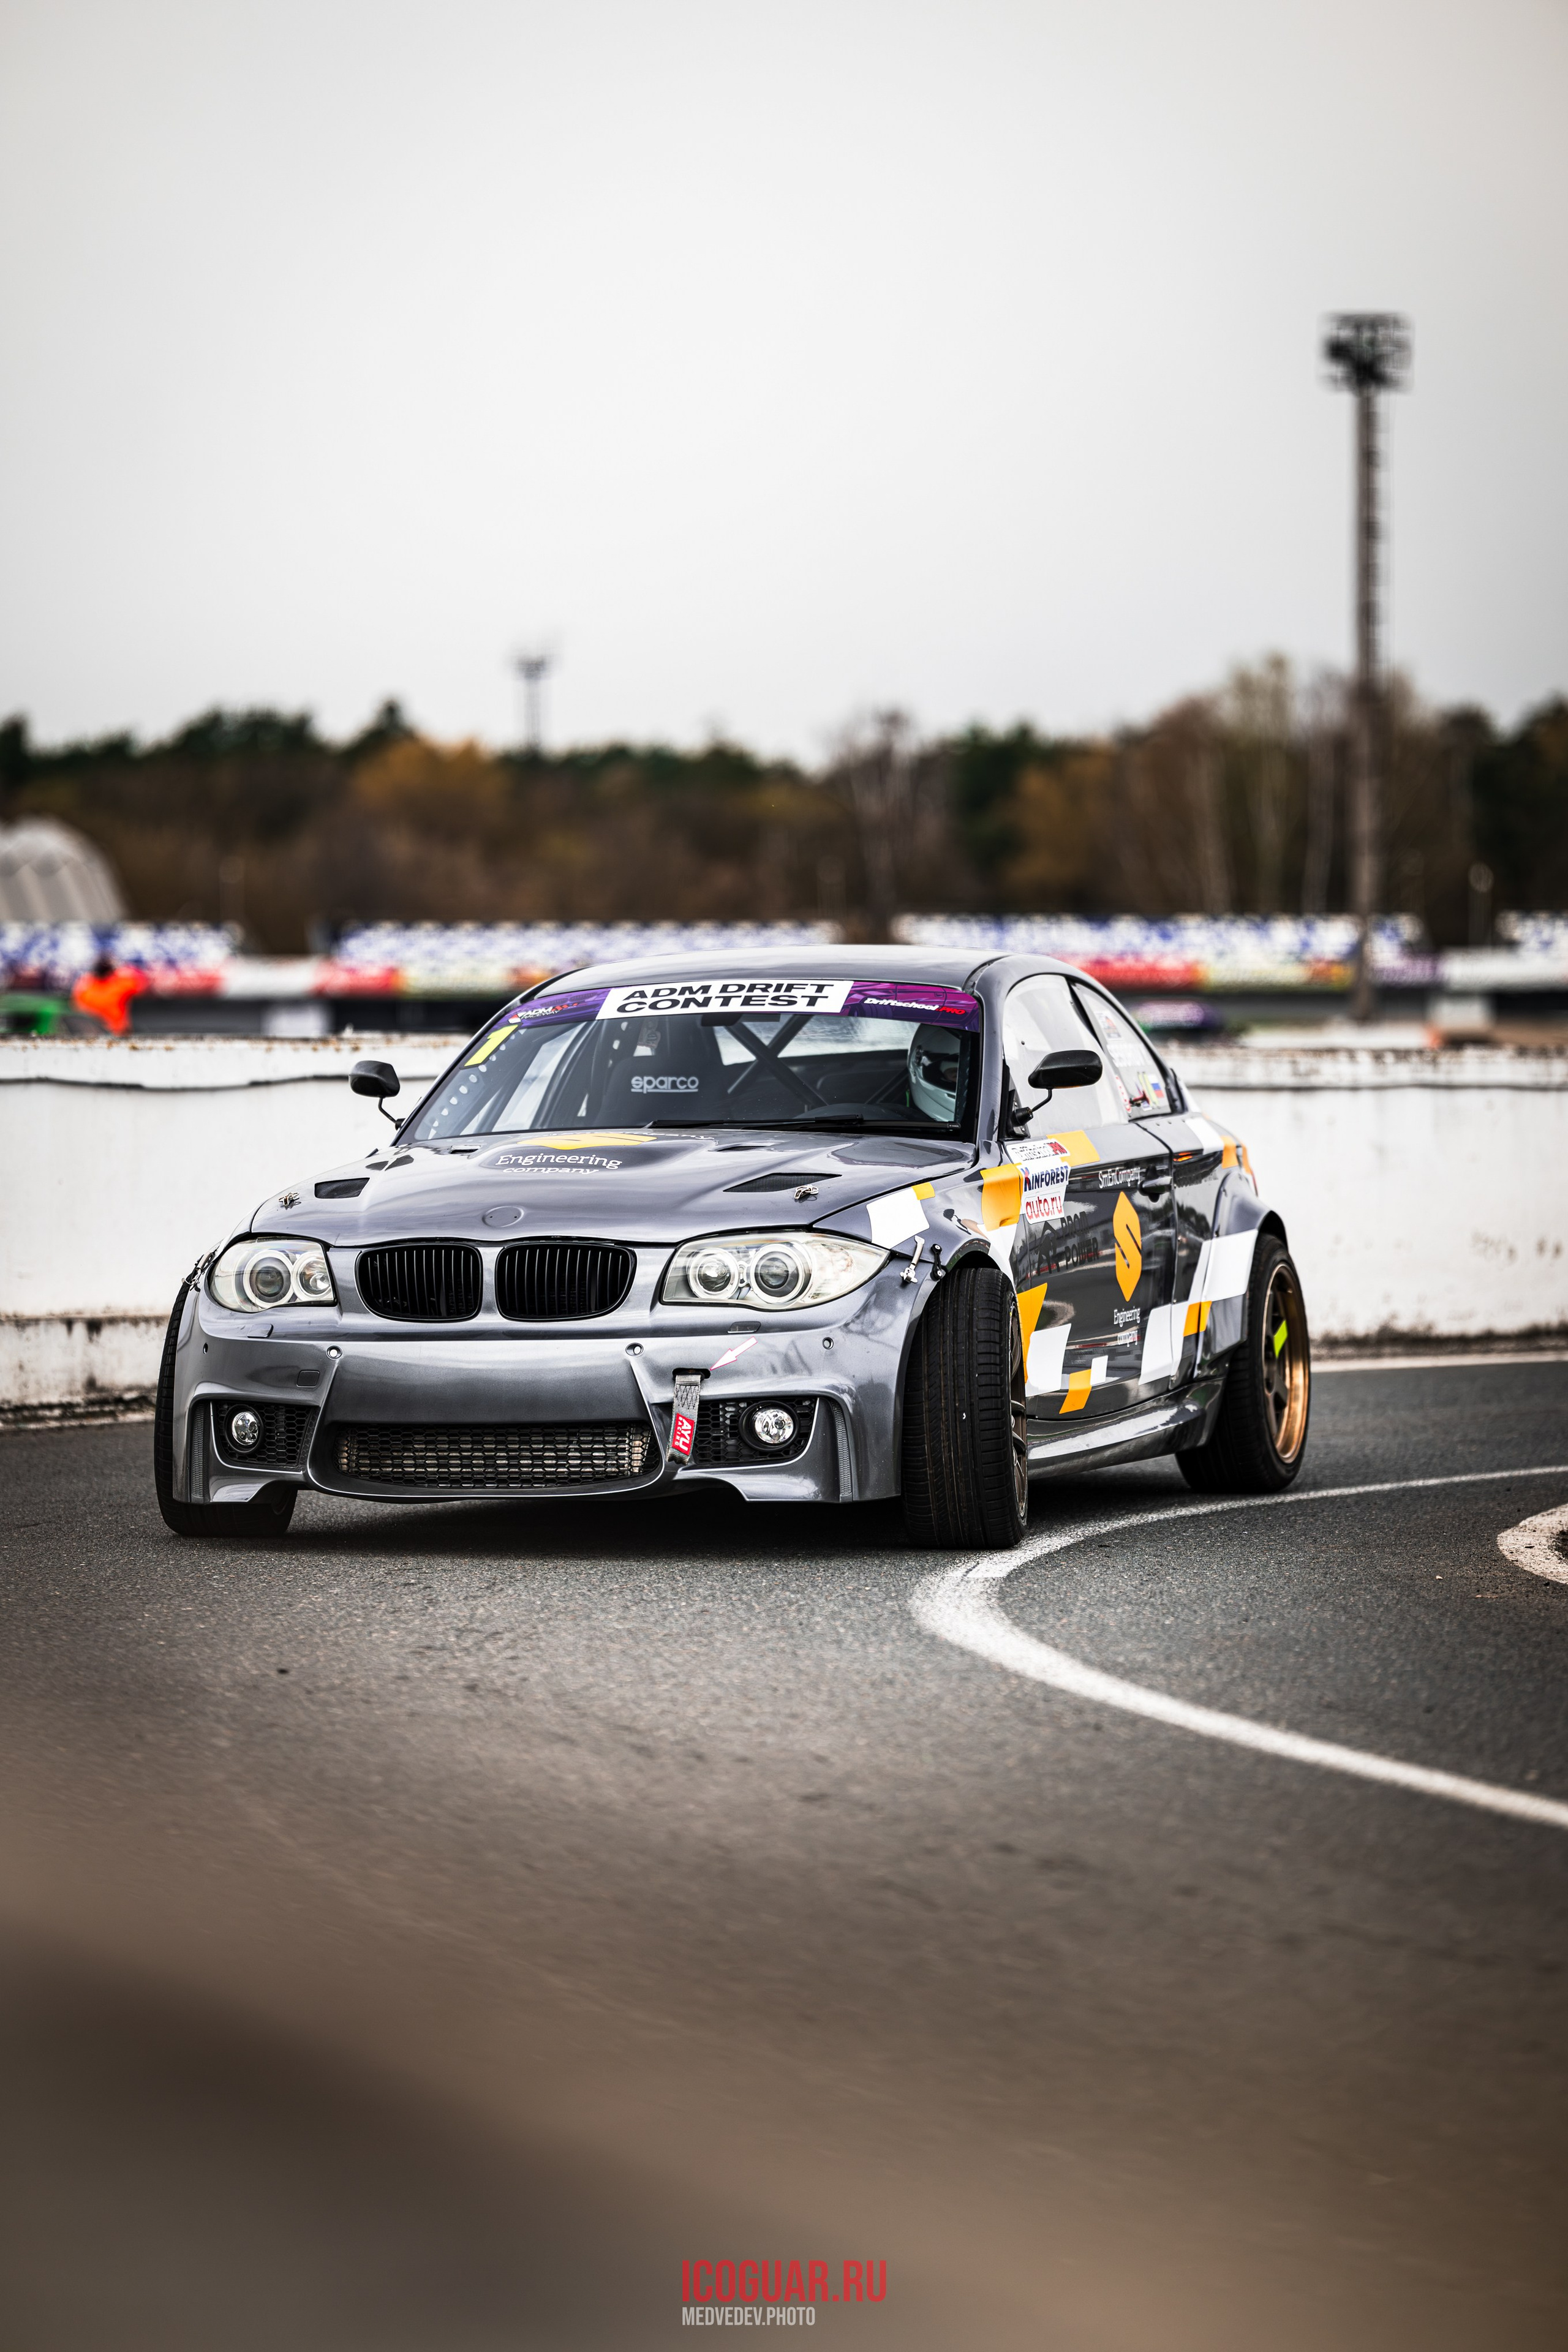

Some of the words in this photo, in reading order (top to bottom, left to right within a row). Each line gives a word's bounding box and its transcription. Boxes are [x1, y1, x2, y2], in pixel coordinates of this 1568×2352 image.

[623, 985, 712, 1001] ADM
[719, 983, 834, 994] DRIFT
[524, 1006, 553, 1016] ADM
[616, 995, 828, 1013] CONTEST
[864, 998, 965, 1015] Driftschool.PRO
[631, 1076, 699, 1094] sparco
[496, 1153, 622, 1169] Engineering
[502, 1166, 599, 1175] company
[1025, 1196, 1063, 1220] auto.ru
[1065, 1237, 1099, 1270] POWER
[1114, 1306, 1140, 1327] Engineering
[679, 1419, 692, 1451] AYU
